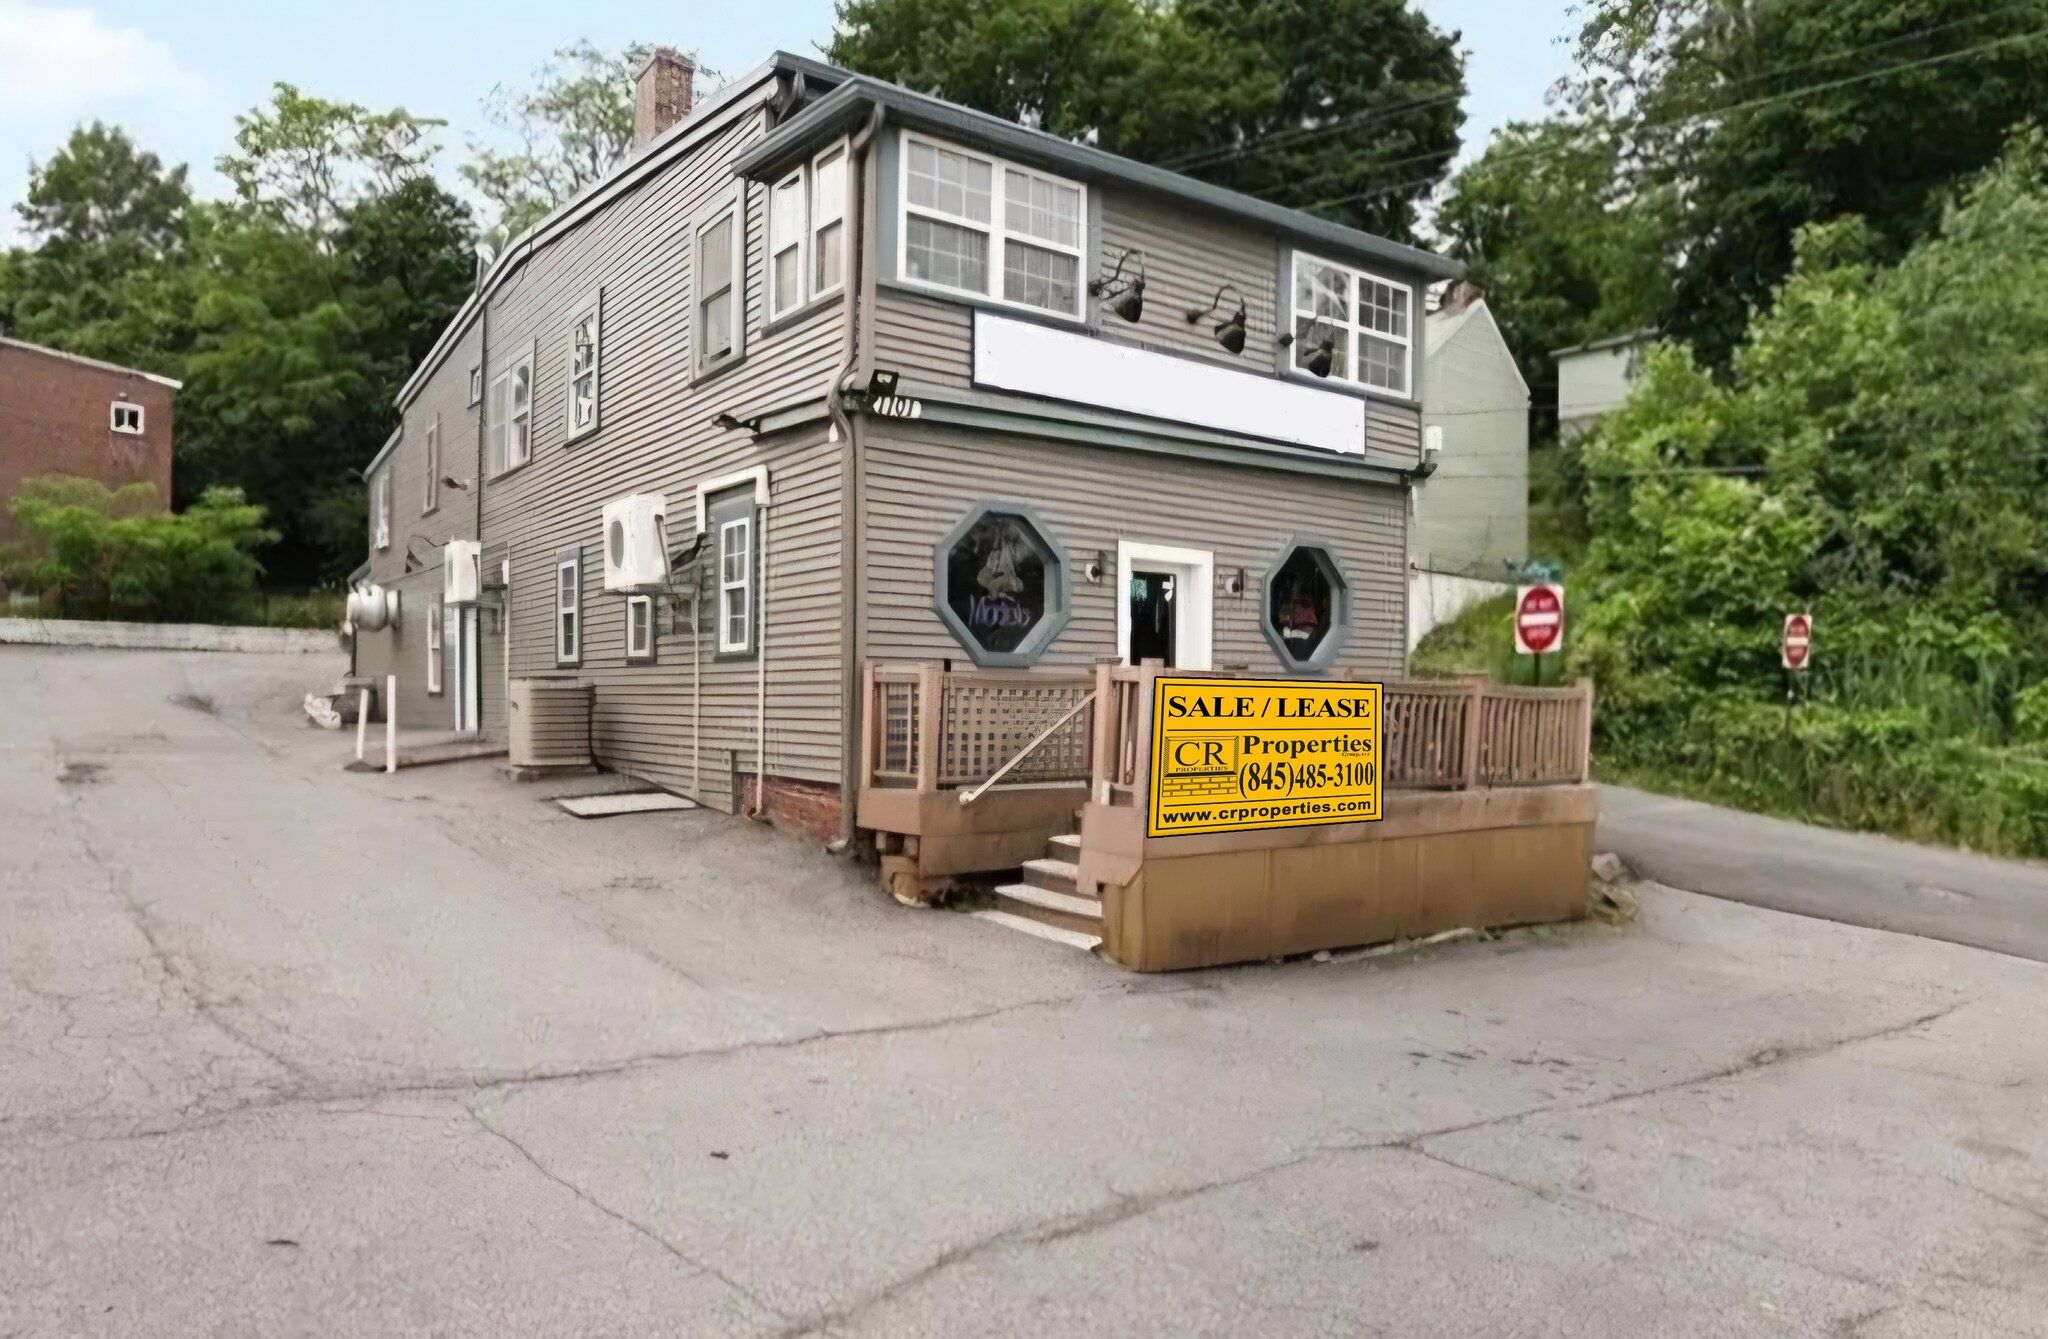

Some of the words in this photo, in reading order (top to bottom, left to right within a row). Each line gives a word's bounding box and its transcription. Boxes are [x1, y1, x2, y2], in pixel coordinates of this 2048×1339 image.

[1168, 695, 1256, 718] SALE
[1276, 697, 1370, 718] LEASE
[1174, 741, 1227, 767] CR
[1241, 734, 1372, 759] Properties
[1239, 761, 1374, 799] (845)485-3100
[1162, 800, 1371, 823] www.crproperties.com
